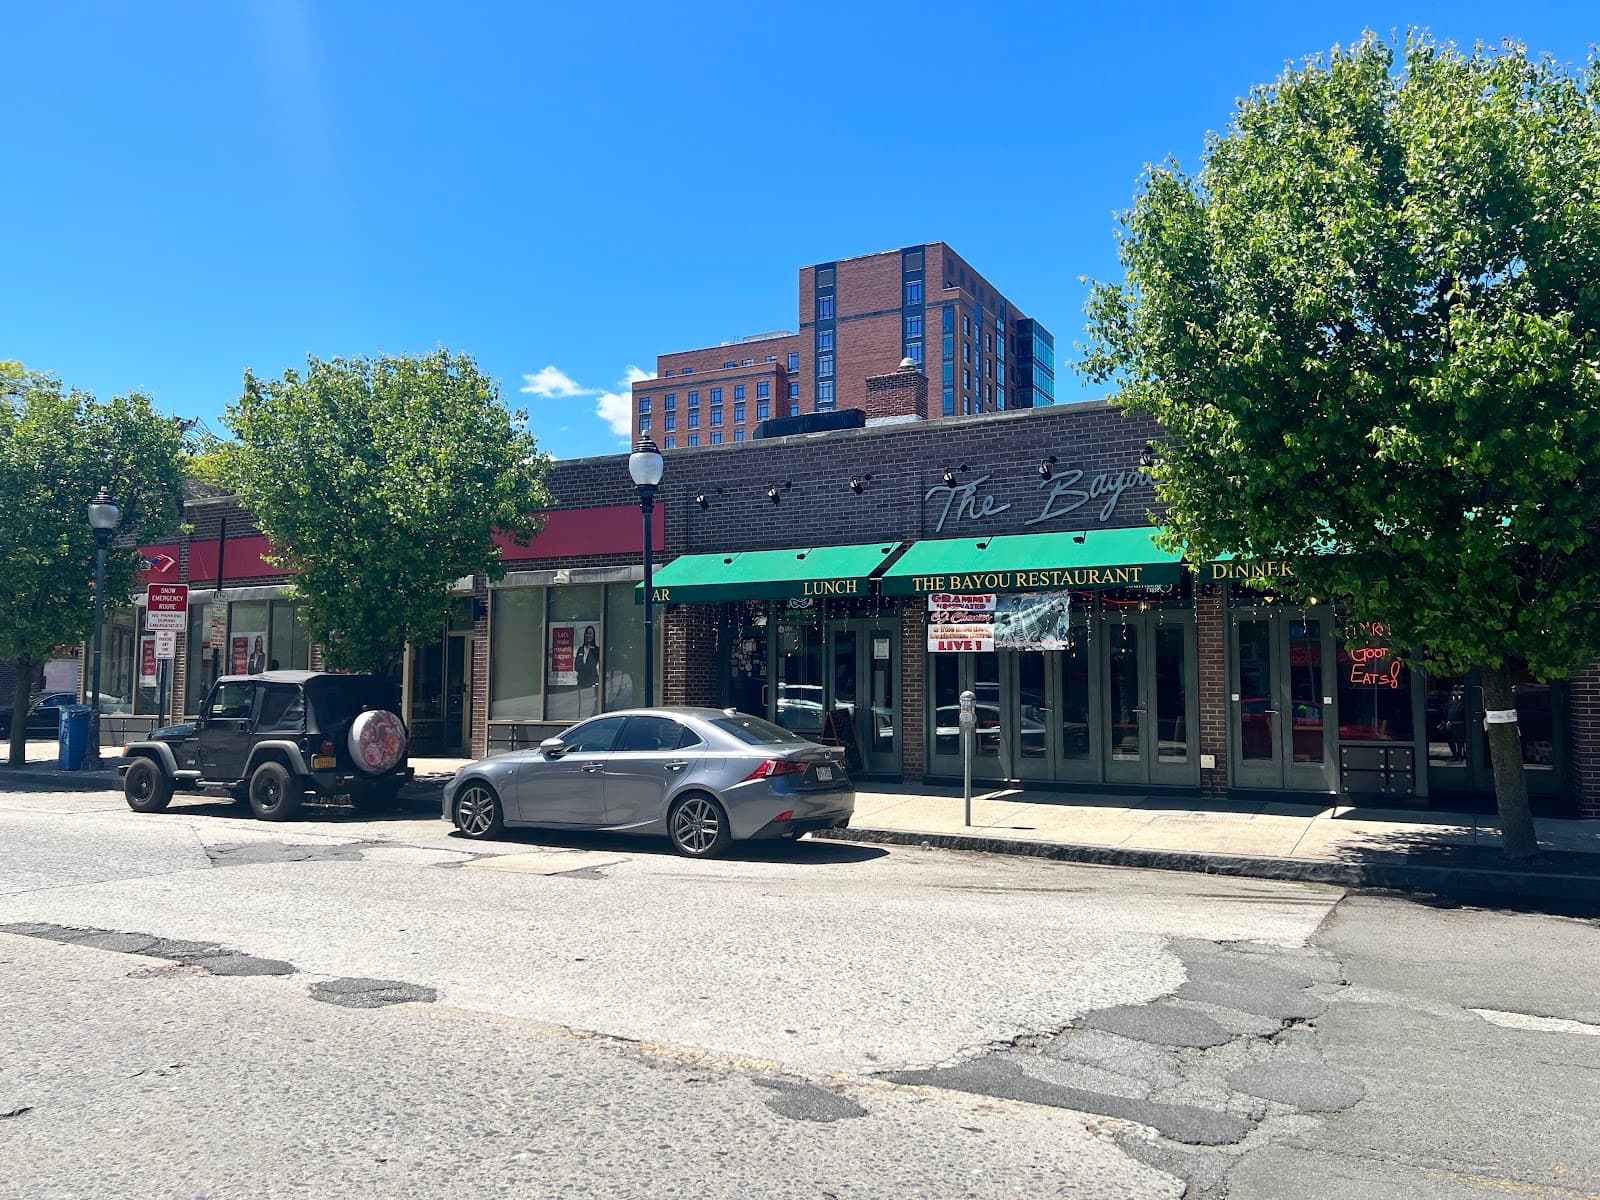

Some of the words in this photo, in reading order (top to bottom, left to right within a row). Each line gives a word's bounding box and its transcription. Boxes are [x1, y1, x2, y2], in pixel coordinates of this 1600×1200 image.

[924, 474, 1011, 533] The
[1023, 469, 1163, 526] Bayou
[1211, 561, 1296, 579] DINNER
[803, 580, 857, 596] LUNCH
[912, 576, 946, 592] THE
[950, 573, 1011, 590] BAYOU
[1016, 567, 1143, 587] RESTAURANT
[650, 588, 671, 602] AR
[931, 594, 992, 603] GRAMMY
